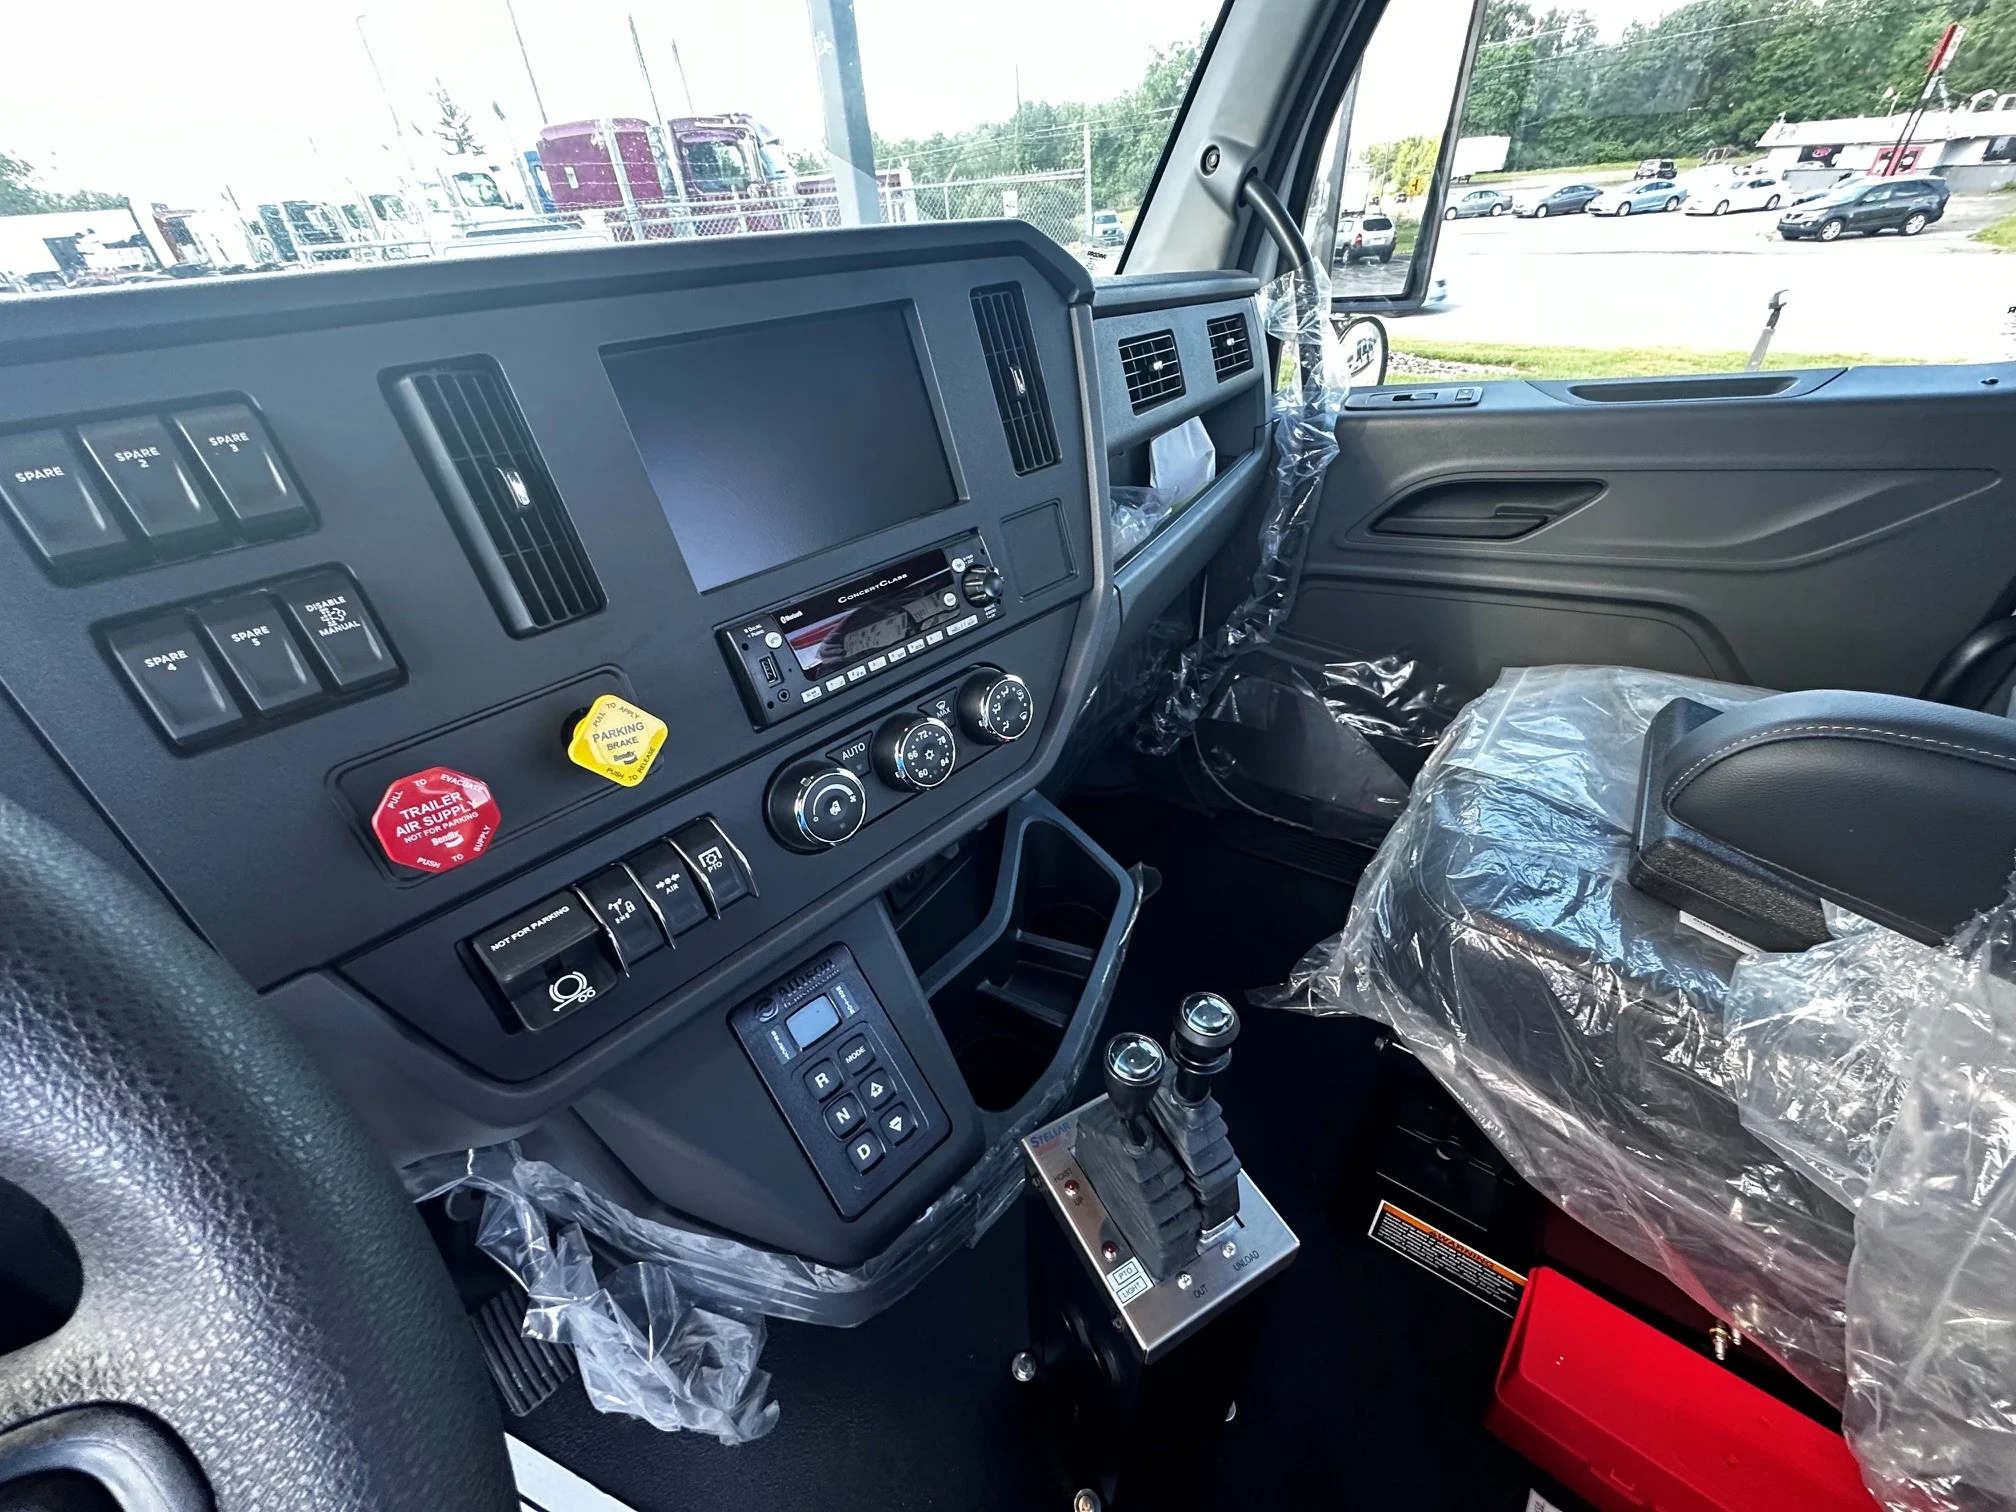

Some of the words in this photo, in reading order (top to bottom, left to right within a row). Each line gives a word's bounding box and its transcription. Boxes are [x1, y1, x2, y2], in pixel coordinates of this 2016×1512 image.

[209, 431, 250, 447] SPARE
[115, 447, 161, 463] SPARE
[229, 443, 239, 453] 3
[139, 458, 149, 468] 2
[15, 466, 65, 483] SPARE
[305, 596, 347, 613] DISABLE
[231, 625, 270, 643] SPARE
[319, 620, 361, 637] MANUAL
[252, 637, 261, 647] 5
[144, 649, 188, 668] SPARE
[166, 662, 177, 672] 4
[593, 712, 606, 727] PULL
[619, 706, 640, 719] APPLY
[936, 706, 951, 719] MAX
[592, 722, 645, 743] PARKING
[918, 730, 929, 740] 72
[937, 736, 947, 745] 78
[606, 736, 639, 751] BRAKE
[841, 742, 866, 760] AUTO
[606, 767, 625, 779] PUSH
[637, 746, 655, 774] RELEASE
[907, 750, 918, 760] 66
[940, 757, 949, 767] 84
[918, 768, 928, 778] 60
[387, 790, 404, 809] PULL
[413, 778, 427, 787] TO
[440, 773, 483, 793] EVACUATE
[400, 792, 464, 820] TRAILER
[396, 820, 421, 837] AIR
[404, 832, 422, 844] NOT
[424, 825, 442, 836] FOR
[443, 811, 479, 830] PARKING
[416, 857, 441, 868] PUSH
[451, 853, 464, 861] TO
[473, 825, 491, 852] SUPPLY
[431, 830, 463, 846] Bendix
[707, 860, 723, 873] PTO
[666, 883, 680, 895] AIR
[490, 936, 511, 951] NOT
[512, 926, 531, 941] FOR
[530, 905, 570, 931] PARKING
[845, 1045, 866, 1064] MODE
[814, 1072, 829, 1088] R
[836, 1107, 851, 1124] N
[1030, 1121, 1071, 1147] STELLAR
[856, 1143, 870, 1160] D
[1437, 1233, 1495, 1269] WARNING
[1233, 1250, 1260, 1272] UNLOAD
[1118, 1267, 1133, 1280] PTO
[1122, 1282, 1142, 1298] LIGHT
[1193, 1284, 1209, 1299] OUT
